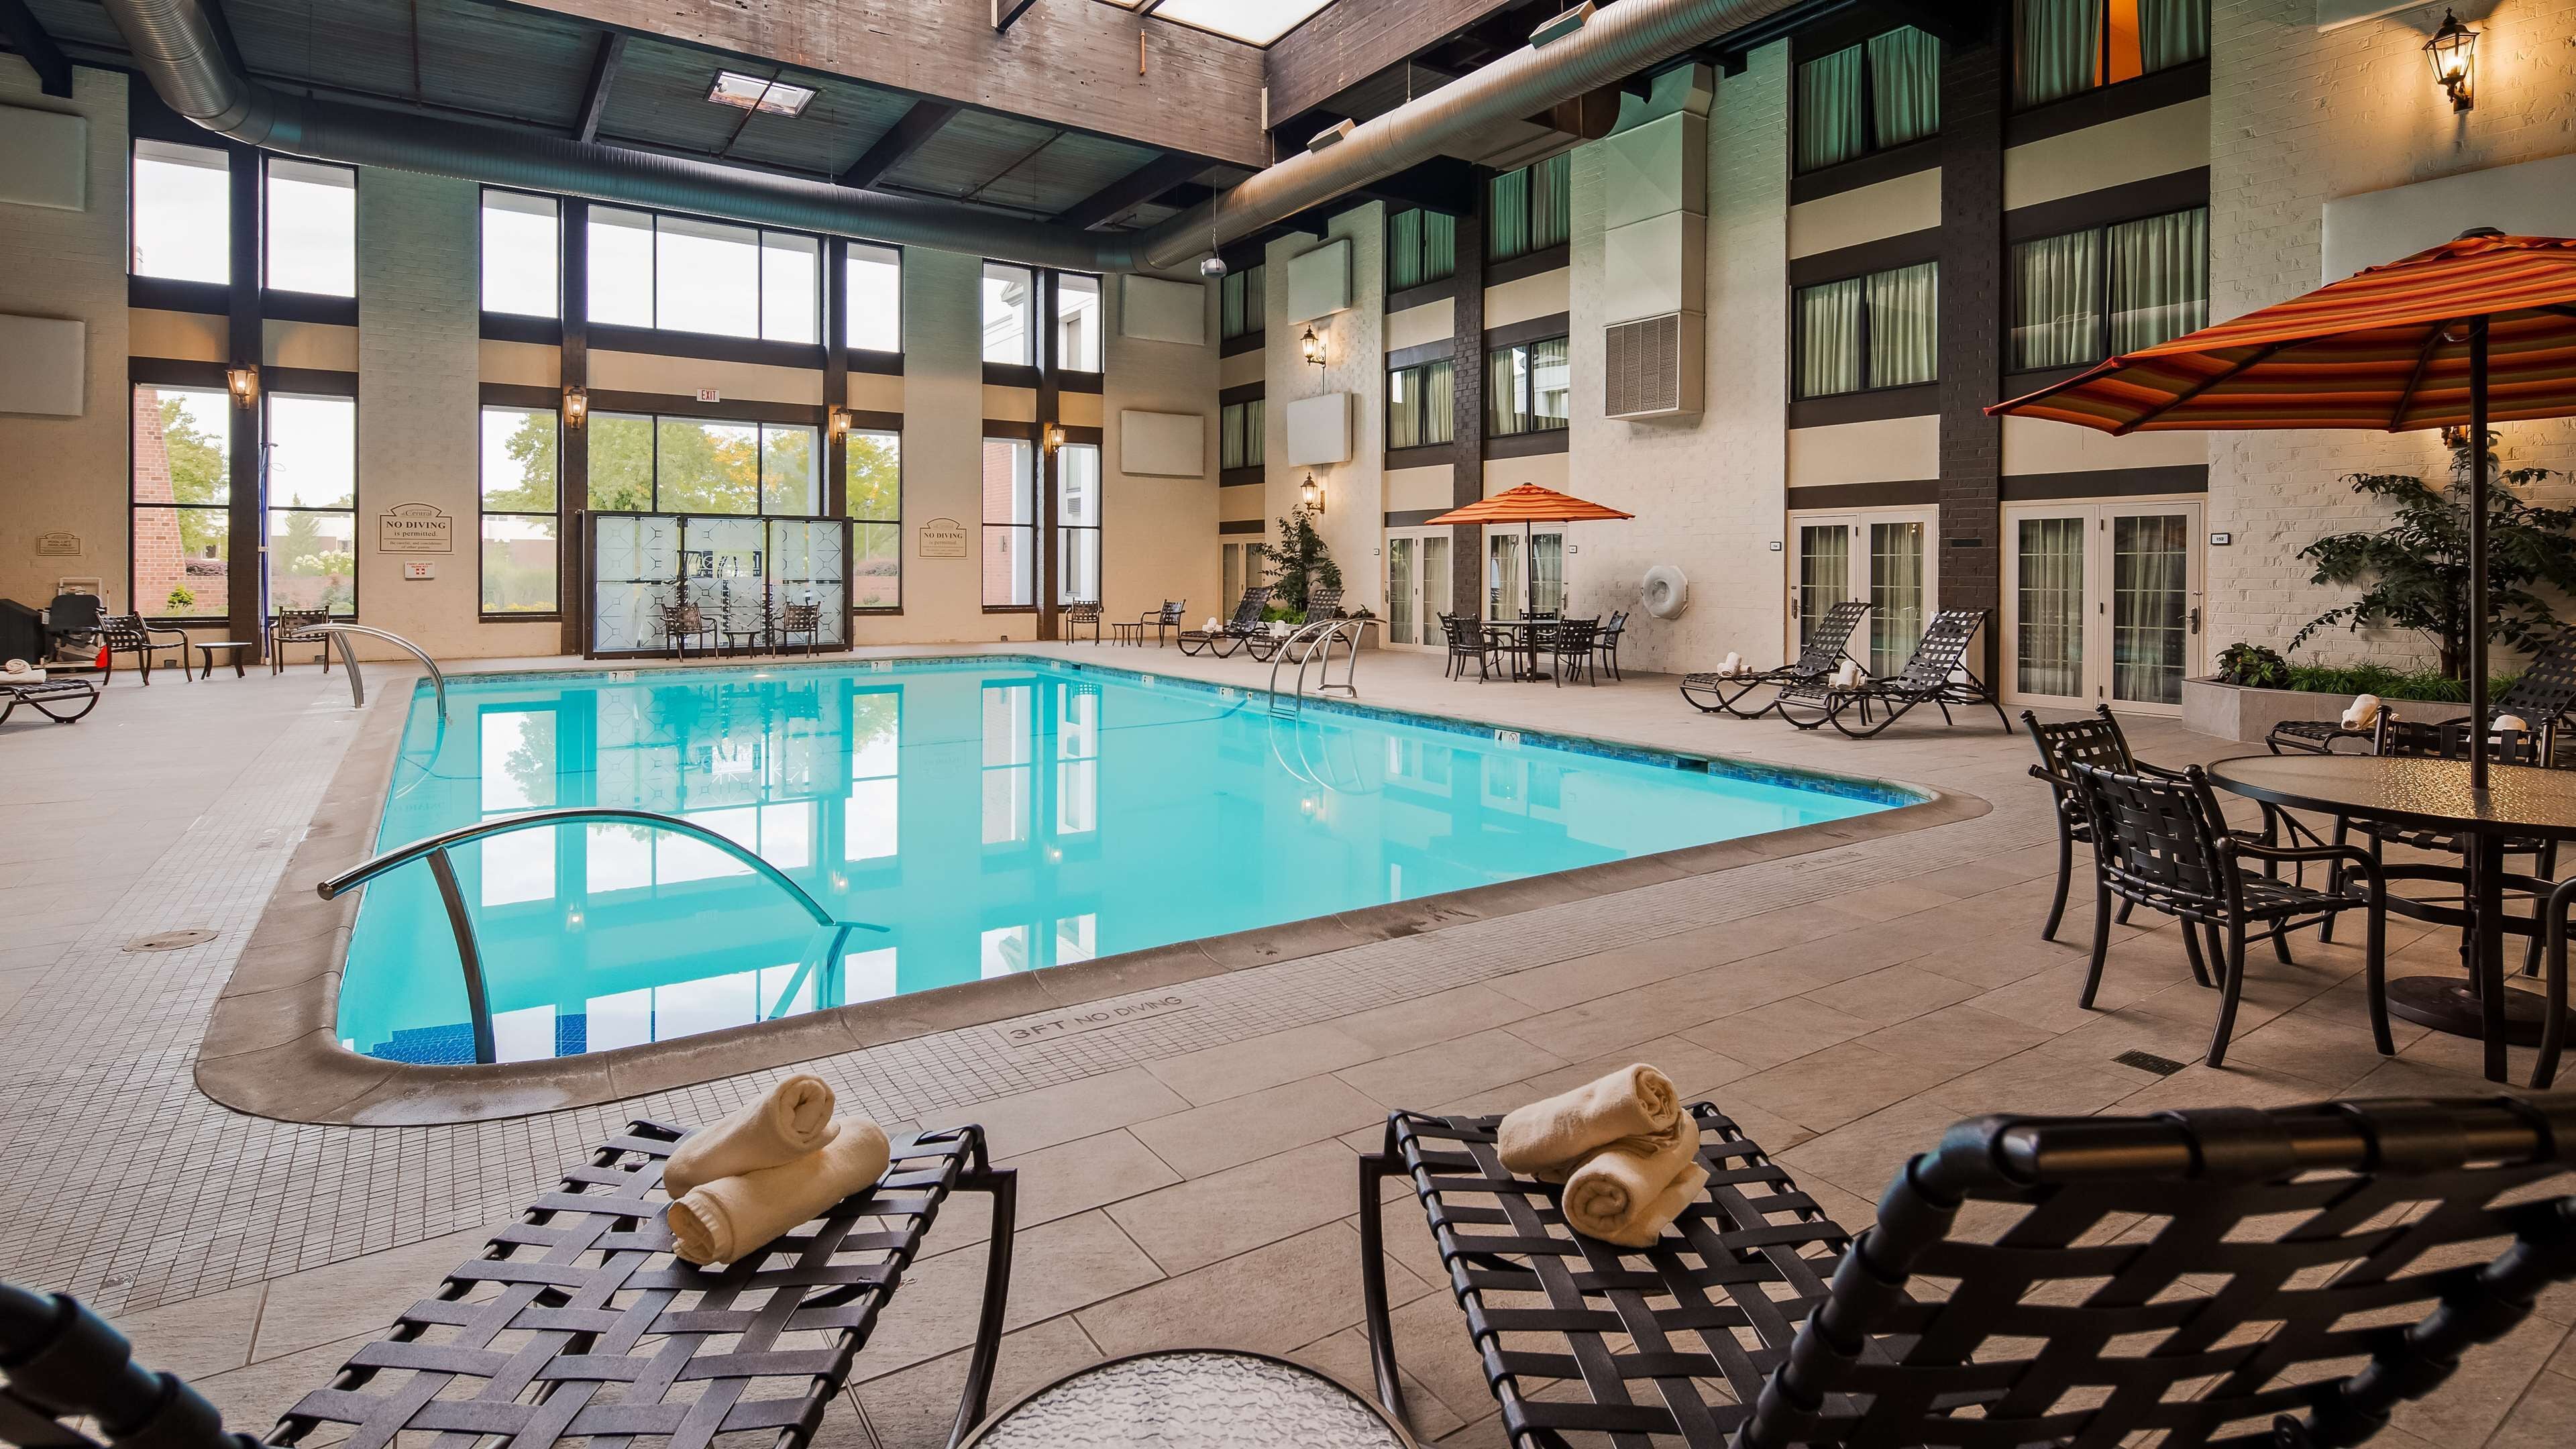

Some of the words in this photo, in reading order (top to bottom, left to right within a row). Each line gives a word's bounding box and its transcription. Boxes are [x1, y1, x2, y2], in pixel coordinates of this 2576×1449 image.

[701, 390, 716, 400] EXIT
[406, 521, 446, 529] DIVING
[1009, 1020, 1065, 1040] 3FT
[1074, 1012, 1110, 1026] NO
[1114, 996, 1183, 1017] DIVING
